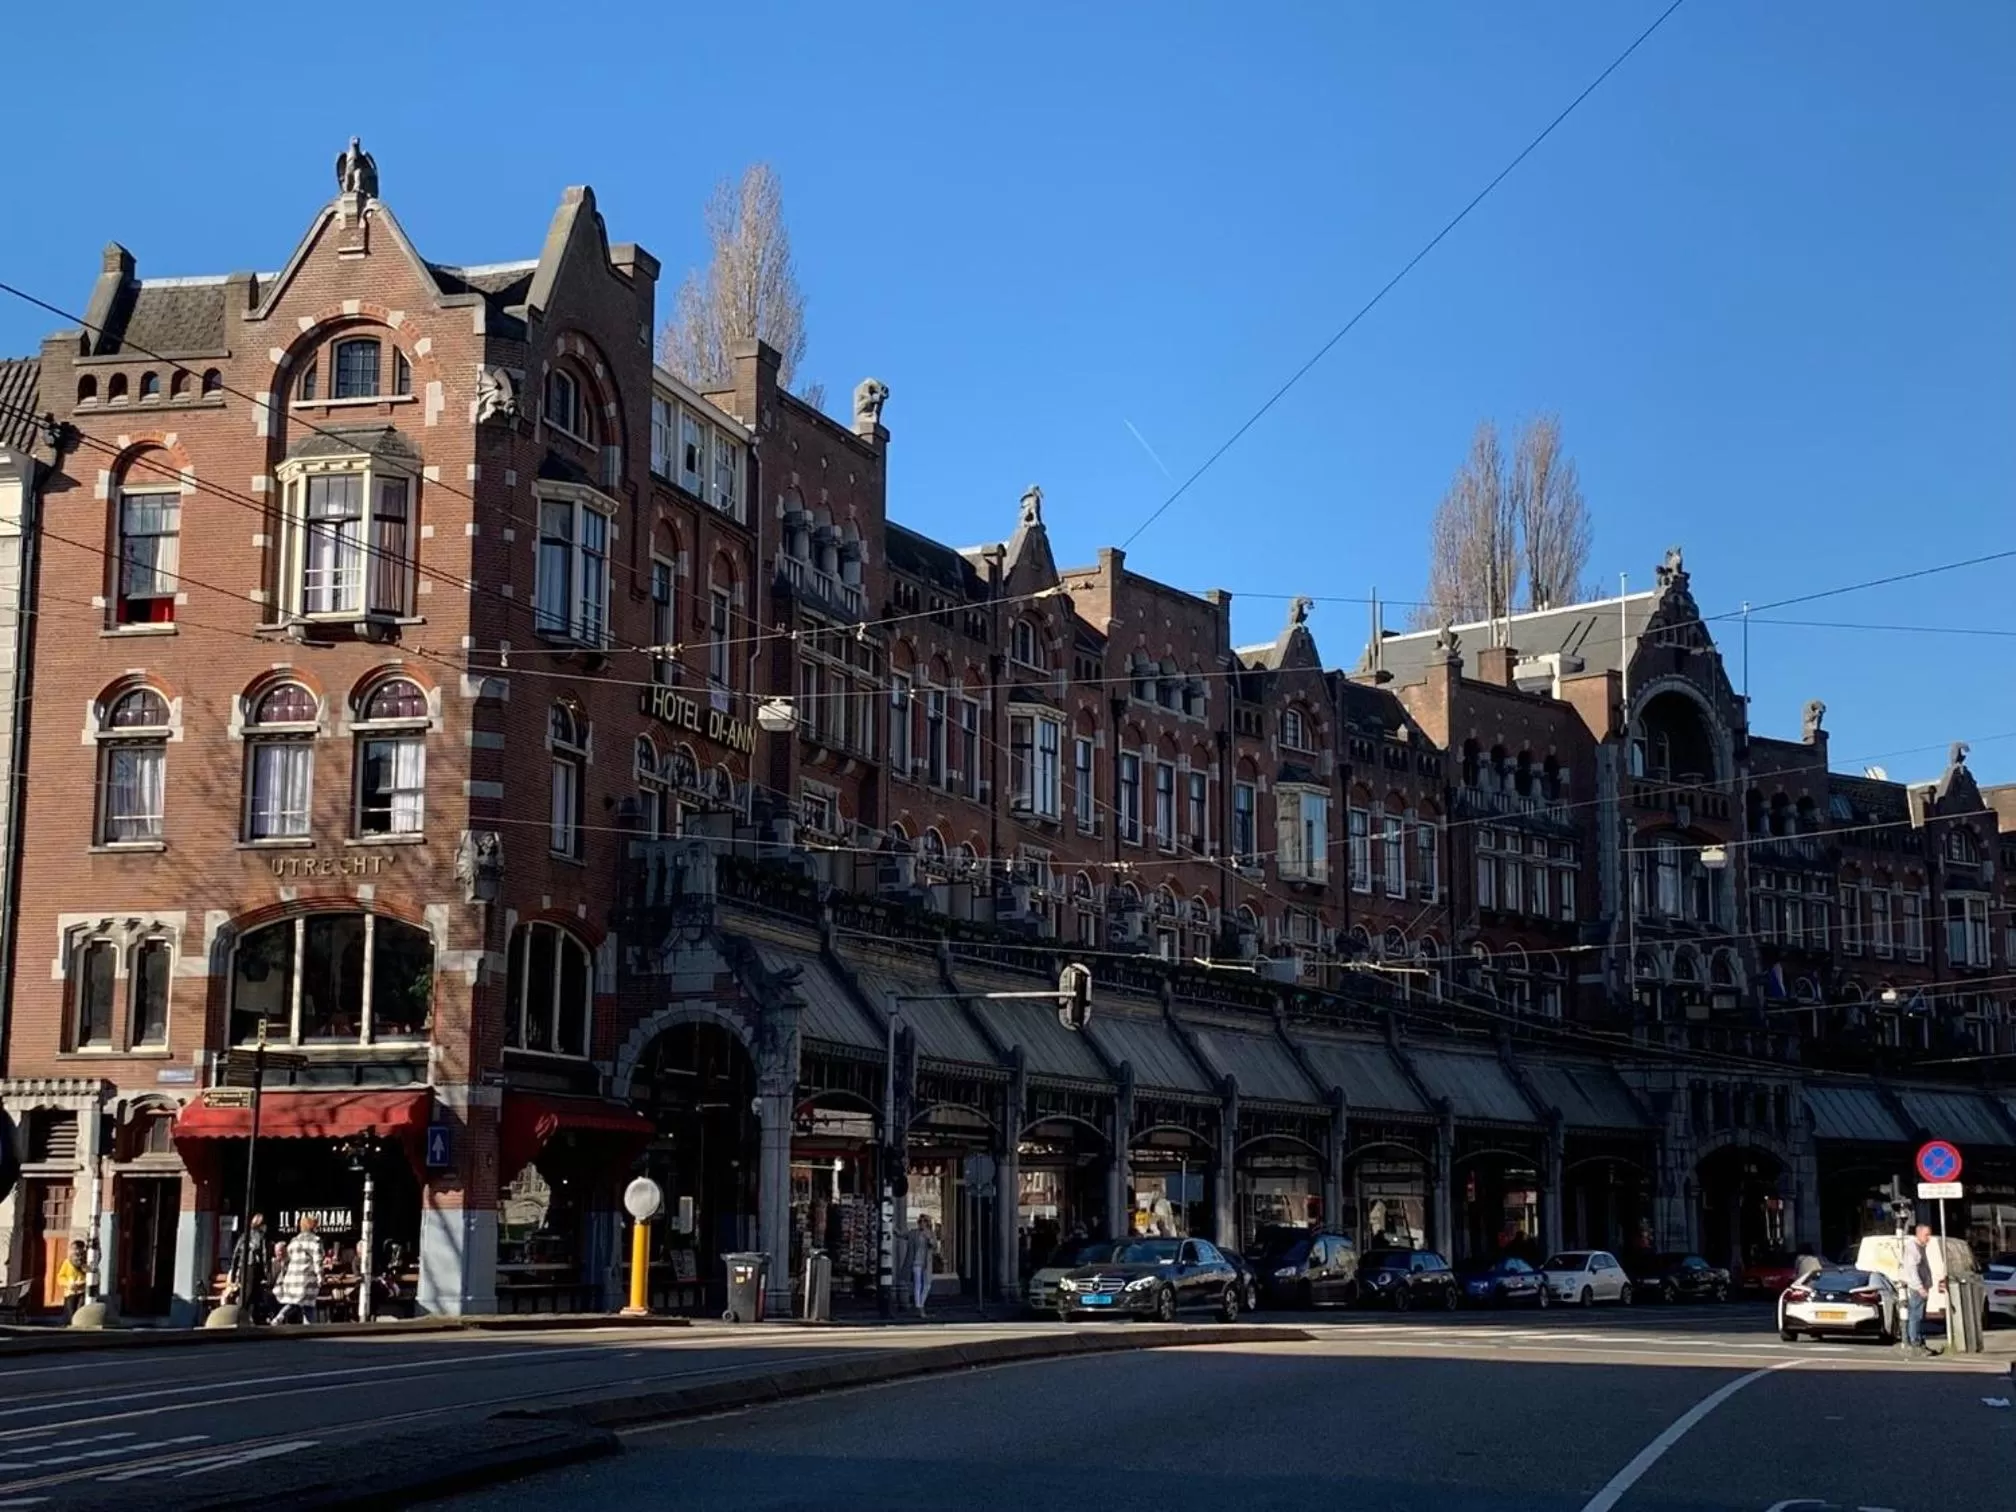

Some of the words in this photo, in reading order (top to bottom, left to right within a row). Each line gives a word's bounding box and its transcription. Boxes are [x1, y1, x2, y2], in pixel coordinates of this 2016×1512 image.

[652, 685, 702, 732] HOTEL
[709, 710, 757, 755] DI-ANN
[272, 855, 383, 877] UTRECHT
[279, 1211, 289, 1227] IL
